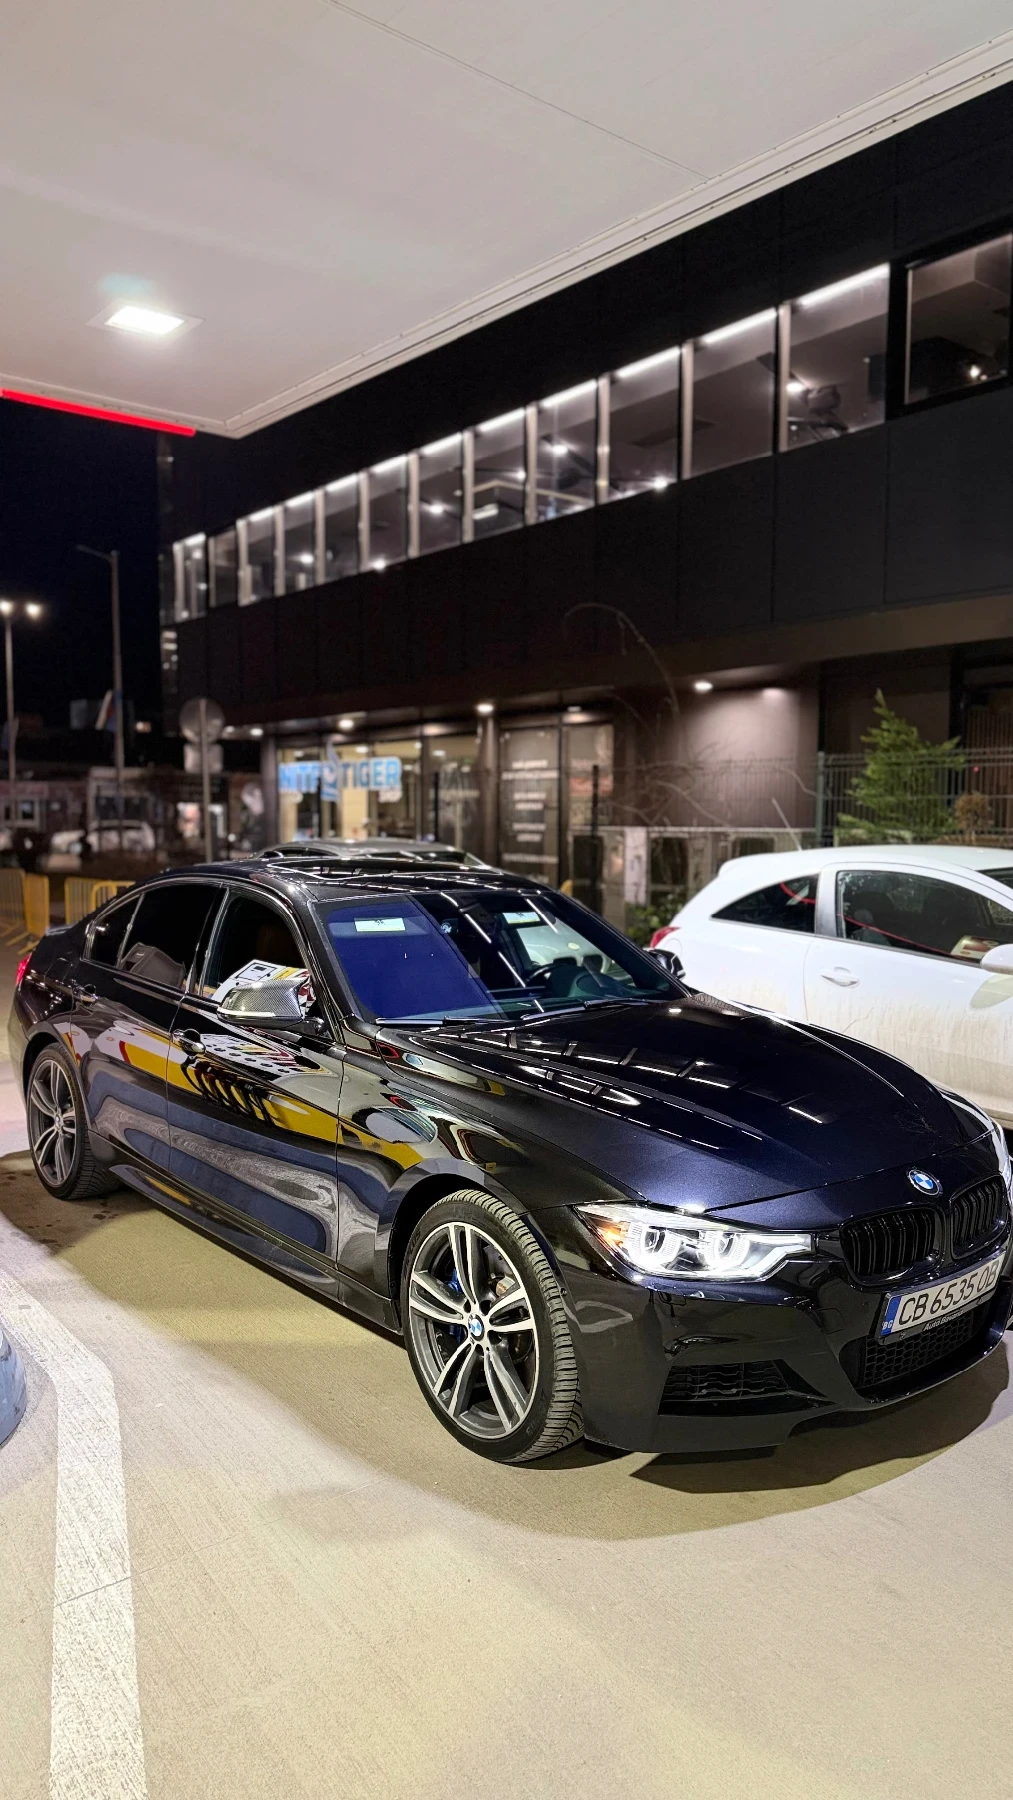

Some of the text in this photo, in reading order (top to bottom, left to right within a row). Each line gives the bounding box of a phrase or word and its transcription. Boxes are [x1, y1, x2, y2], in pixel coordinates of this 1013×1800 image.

[342, 758, 399, 789] TIGER
[899, 1293, 929, 1325] CB
[930, 1272, 979, 1314] 6535
[882, 1320, 893, 1330] BG
[923, 1319, 941, 1331] Auto
